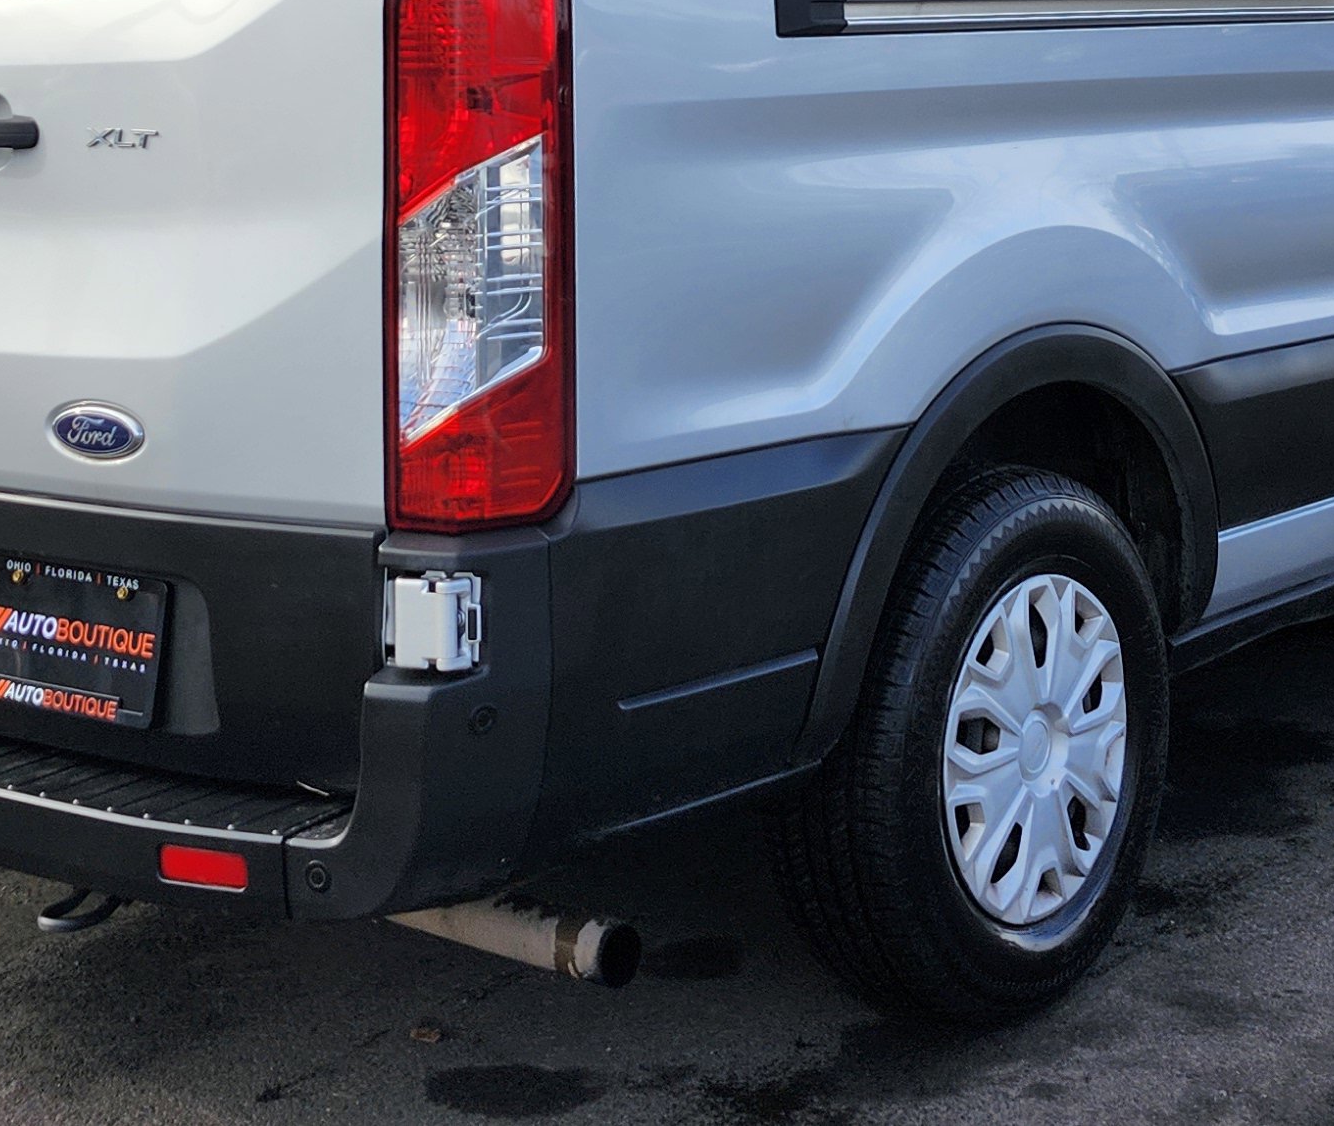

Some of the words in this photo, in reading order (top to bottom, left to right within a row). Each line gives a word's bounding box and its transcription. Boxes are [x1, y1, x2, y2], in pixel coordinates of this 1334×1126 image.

[86, 127, 159, 149] XLT
[67, 415, 118, 446] Ford
[6, 559, 31, 572] OHIO
[45, 565, 93, 582] FLORIDA
[106, 575, 139, 590] TEXAS
[3, 609, 156, 659] AUTOBOUTIQUE
[32, 642, 87, 661] FLORIDA
[104, 656, 146, 673] TEXAS
[3, 681, 118, 722] AUTOBOUTIQUE
